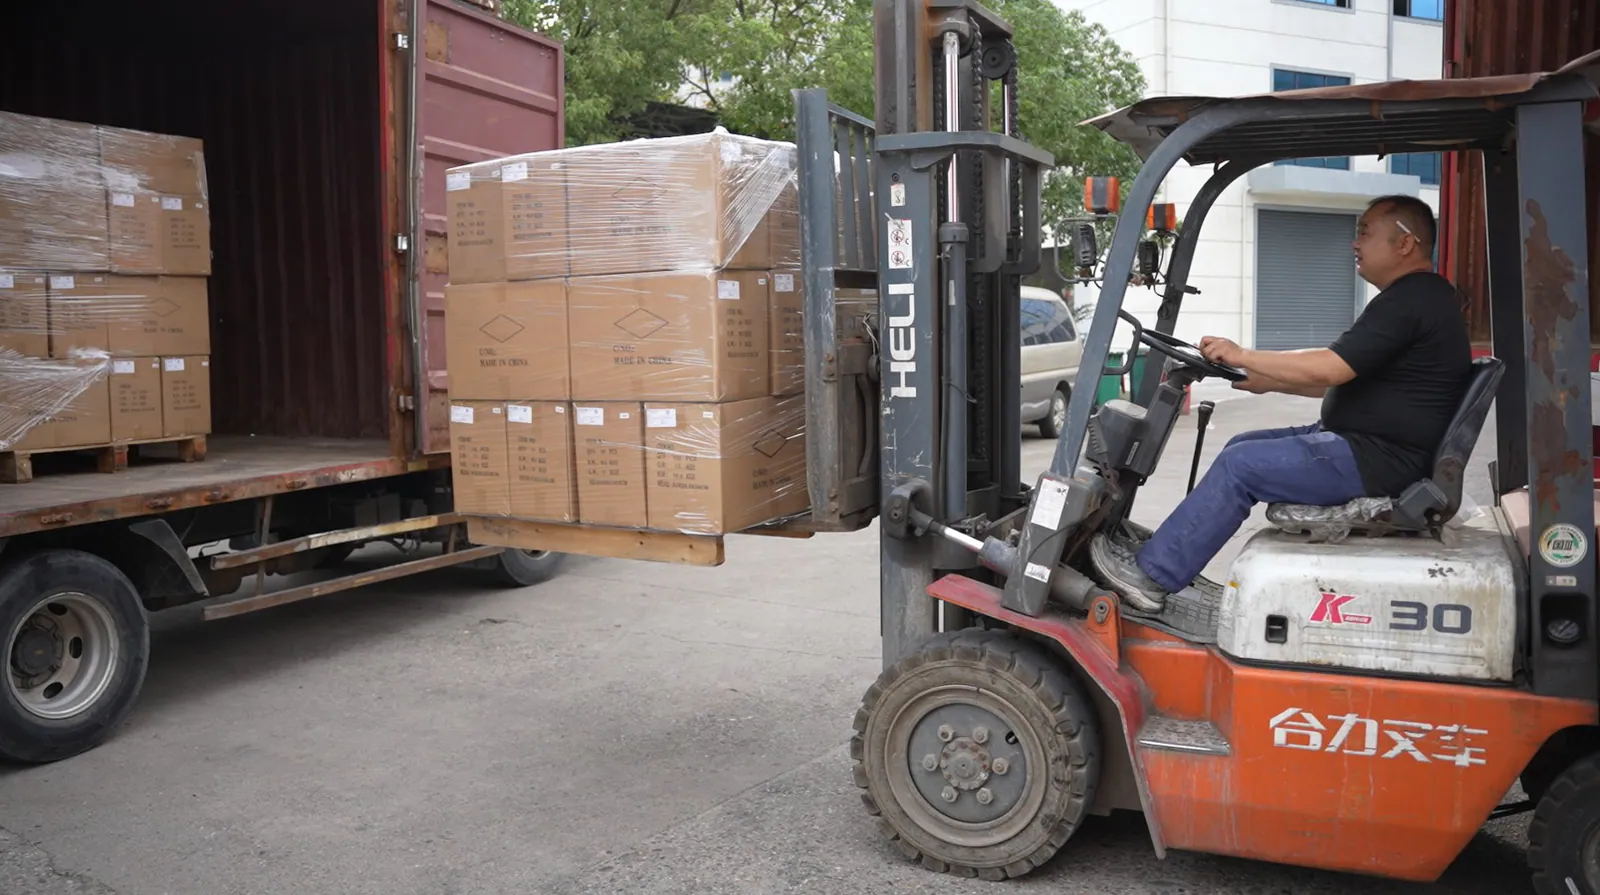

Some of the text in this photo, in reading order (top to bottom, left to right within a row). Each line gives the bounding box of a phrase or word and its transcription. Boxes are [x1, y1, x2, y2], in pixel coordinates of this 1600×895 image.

[479, 359, 497, 367] MADE
[888, 283, 917, 398] HELI
[1309, 592, 1472, 634] K 30
[1269, 707, 1489, 767] 合力叉车
